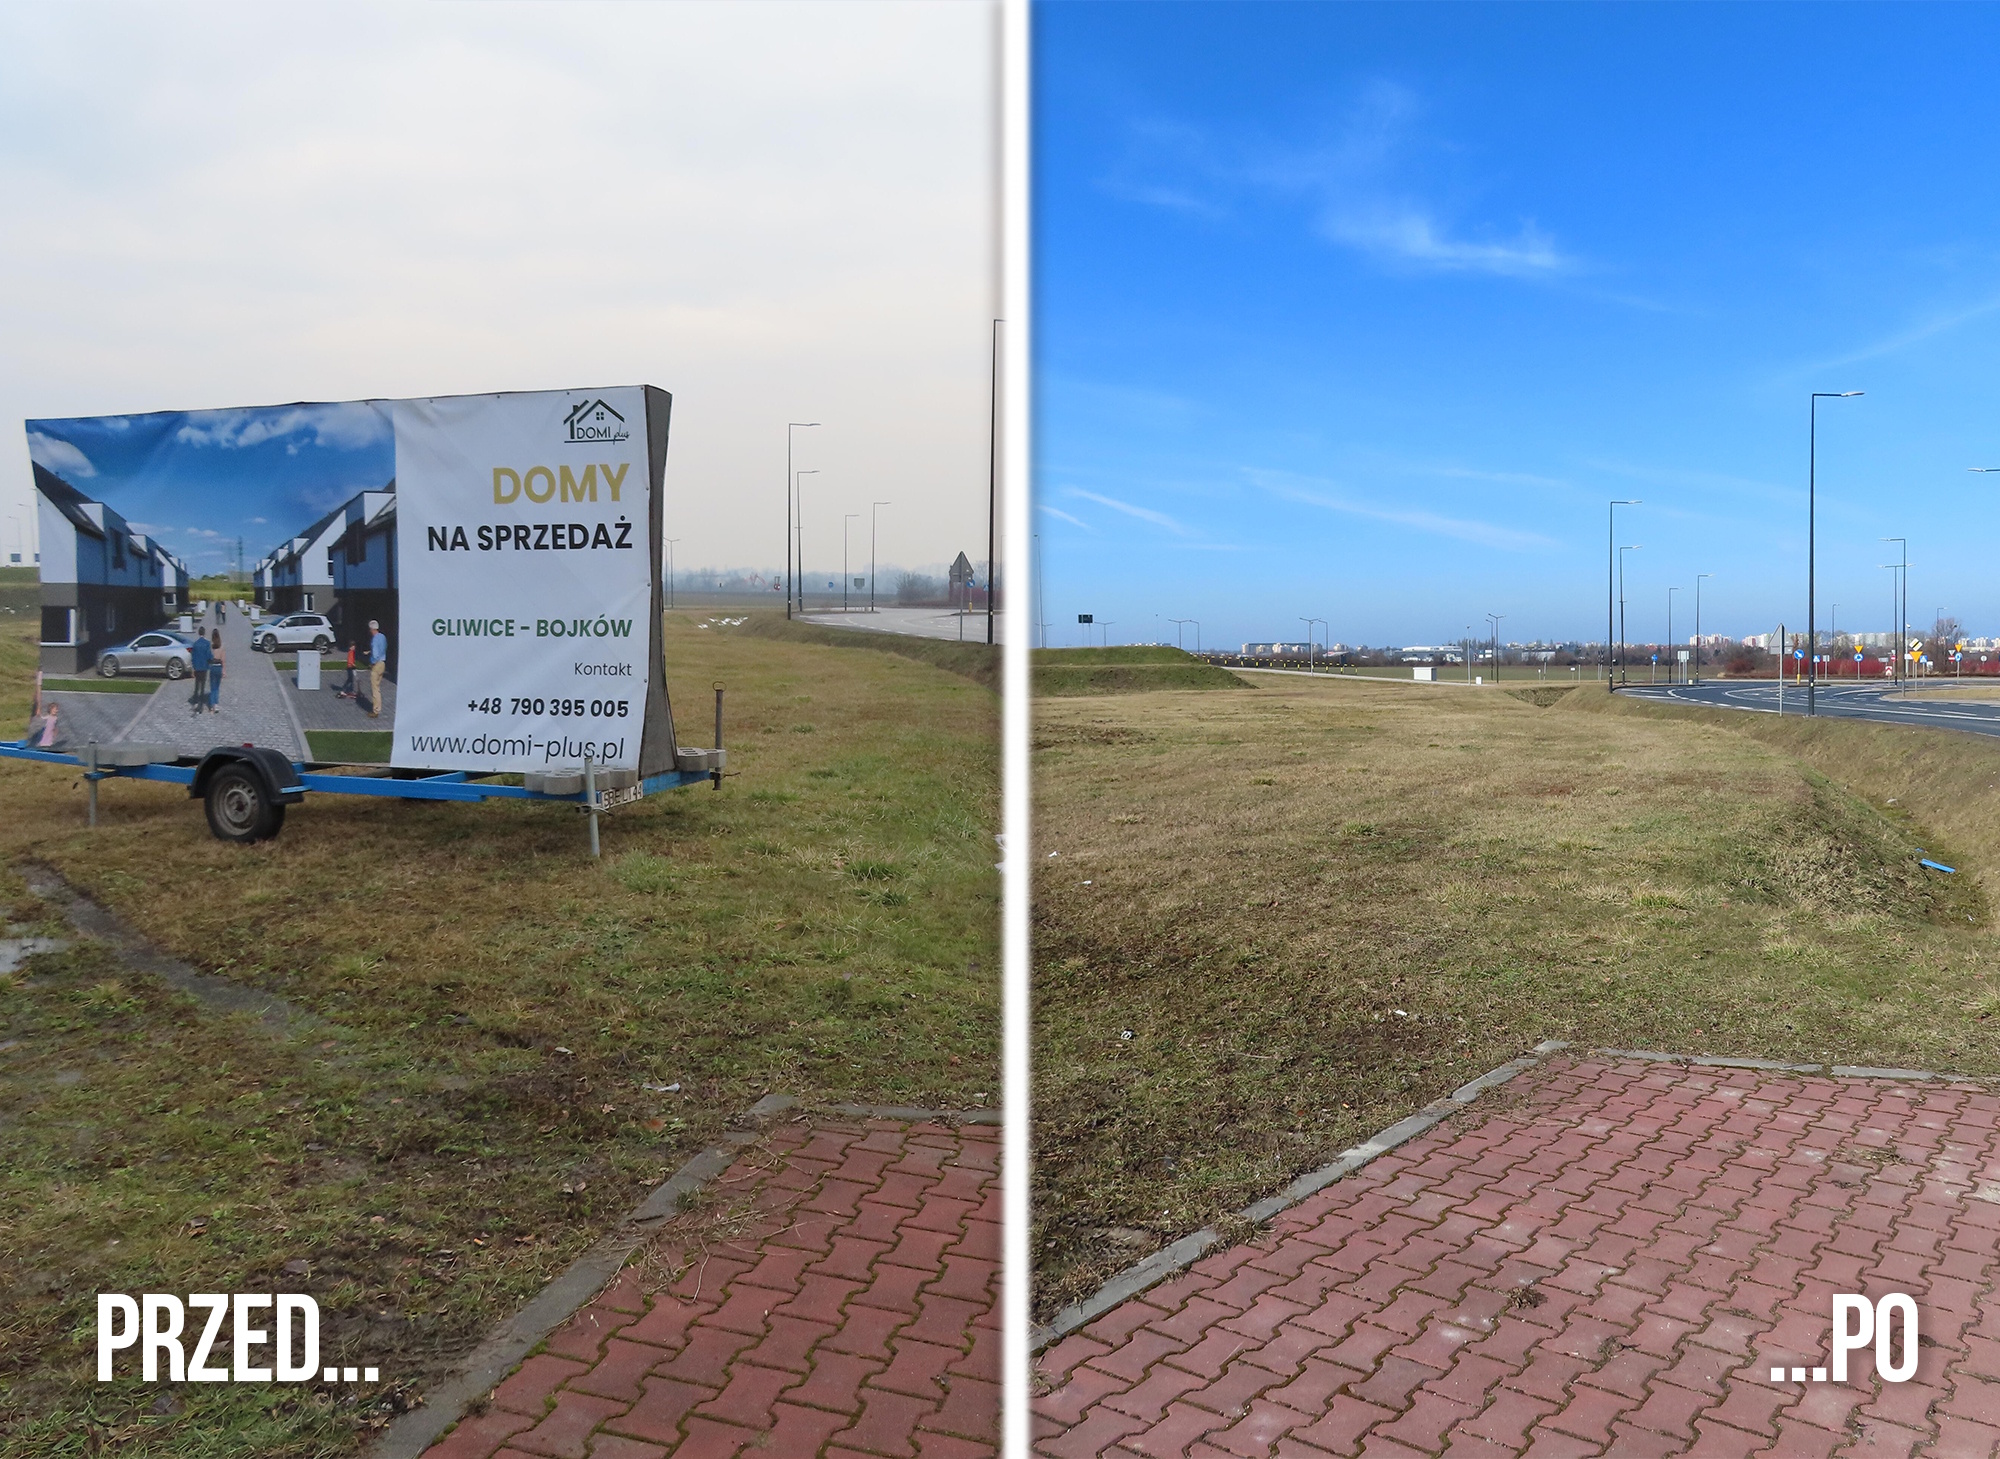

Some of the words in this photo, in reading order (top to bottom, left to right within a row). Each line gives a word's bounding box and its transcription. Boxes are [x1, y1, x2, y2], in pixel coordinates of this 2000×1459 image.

[576, 426, 611, 440] DOMI
[492, 463, 630, 504] DOMY
[427, 525, 470, 552] NA
[477, 515, 633, 551] SPRZEDAŻ
[431, 618, 515, 637] GLIWICE
[536, 613, 633, 638] BOJKÓW
[574, 662, 632, 677] Kontakt
[467, 697, 502, 715] +48
[510, 698, 545, 716] 790
[549, 698, 585, 717] 395
[590, 699, 629, 718] 005
[411, 733, 624, 764] www.domi-plus.pl
